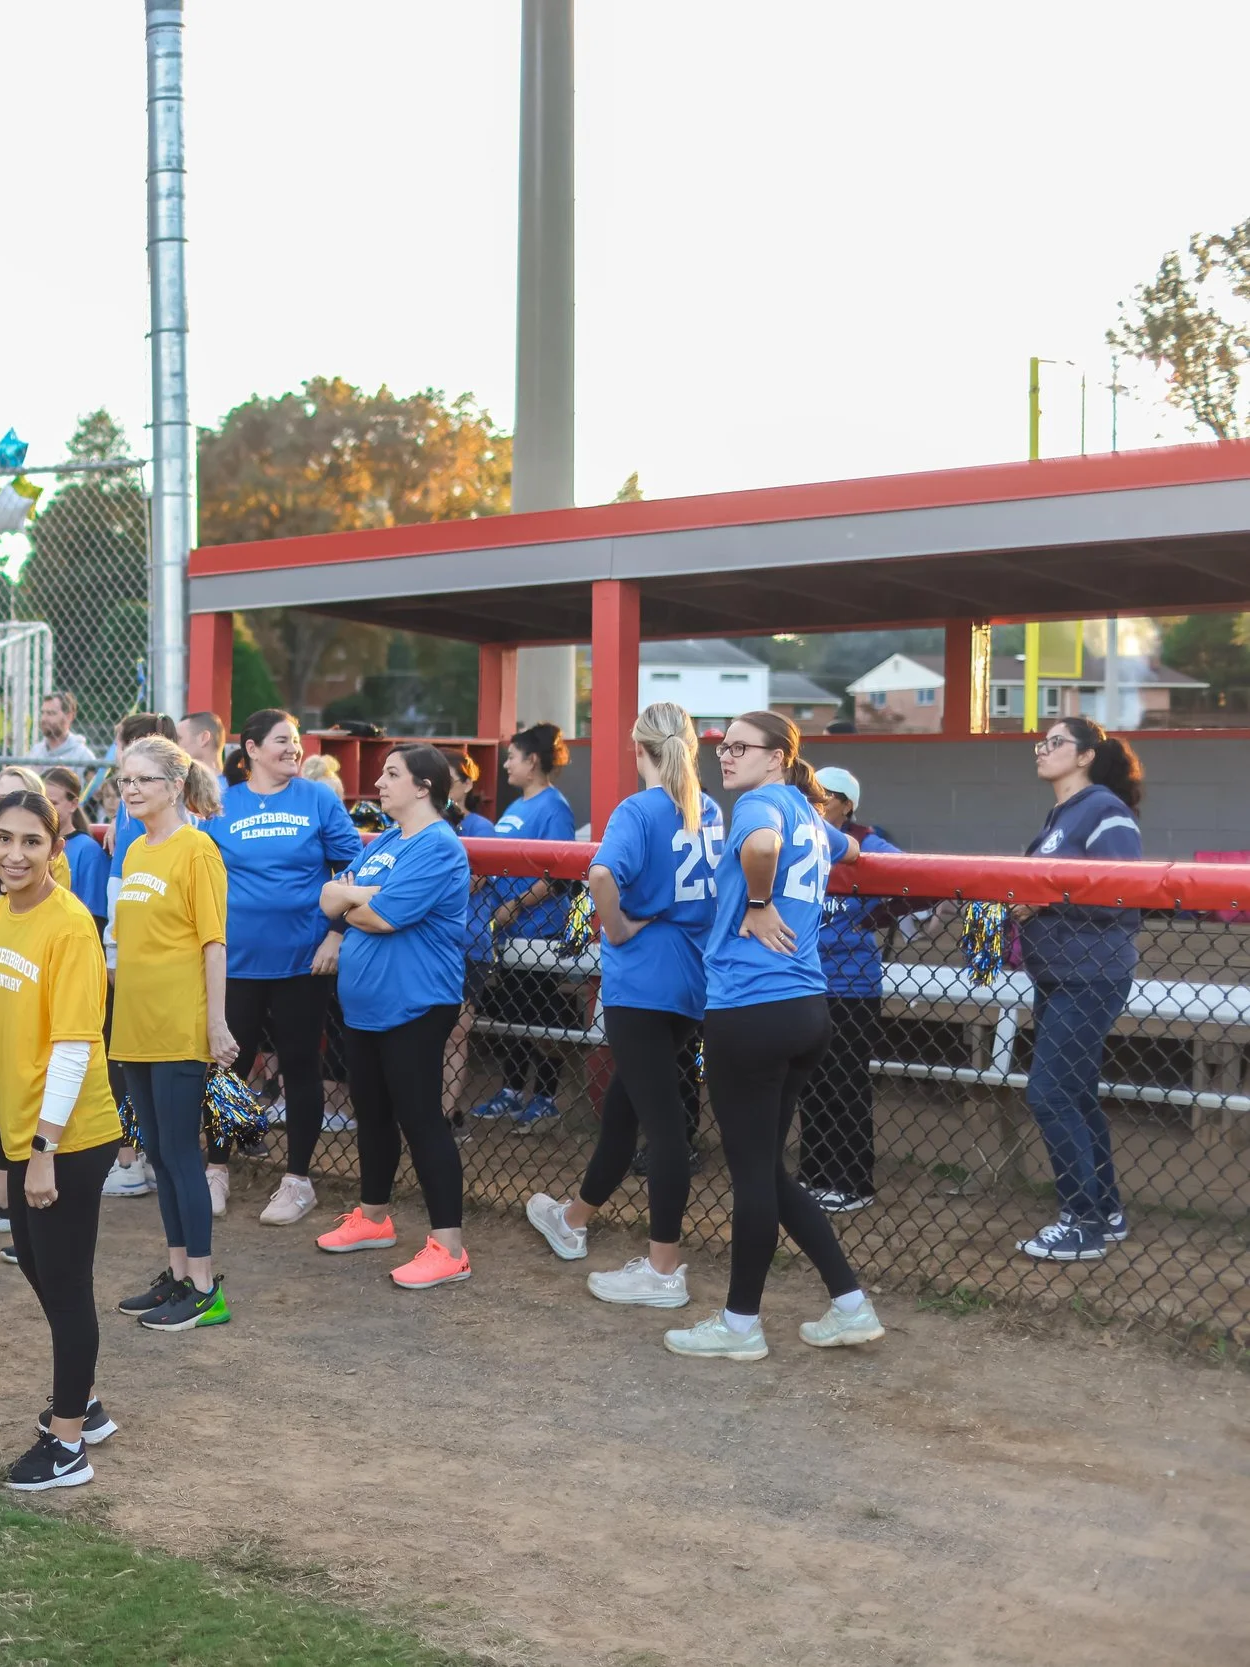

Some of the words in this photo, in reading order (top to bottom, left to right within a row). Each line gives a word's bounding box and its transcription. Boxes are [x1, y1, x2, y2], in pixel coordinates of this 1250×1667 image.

[230, 812, 310, 834] CHESTERBROOK
[241, 827, 298, 840] ELEMENTARY
[672, 825, 724, 903] 25
